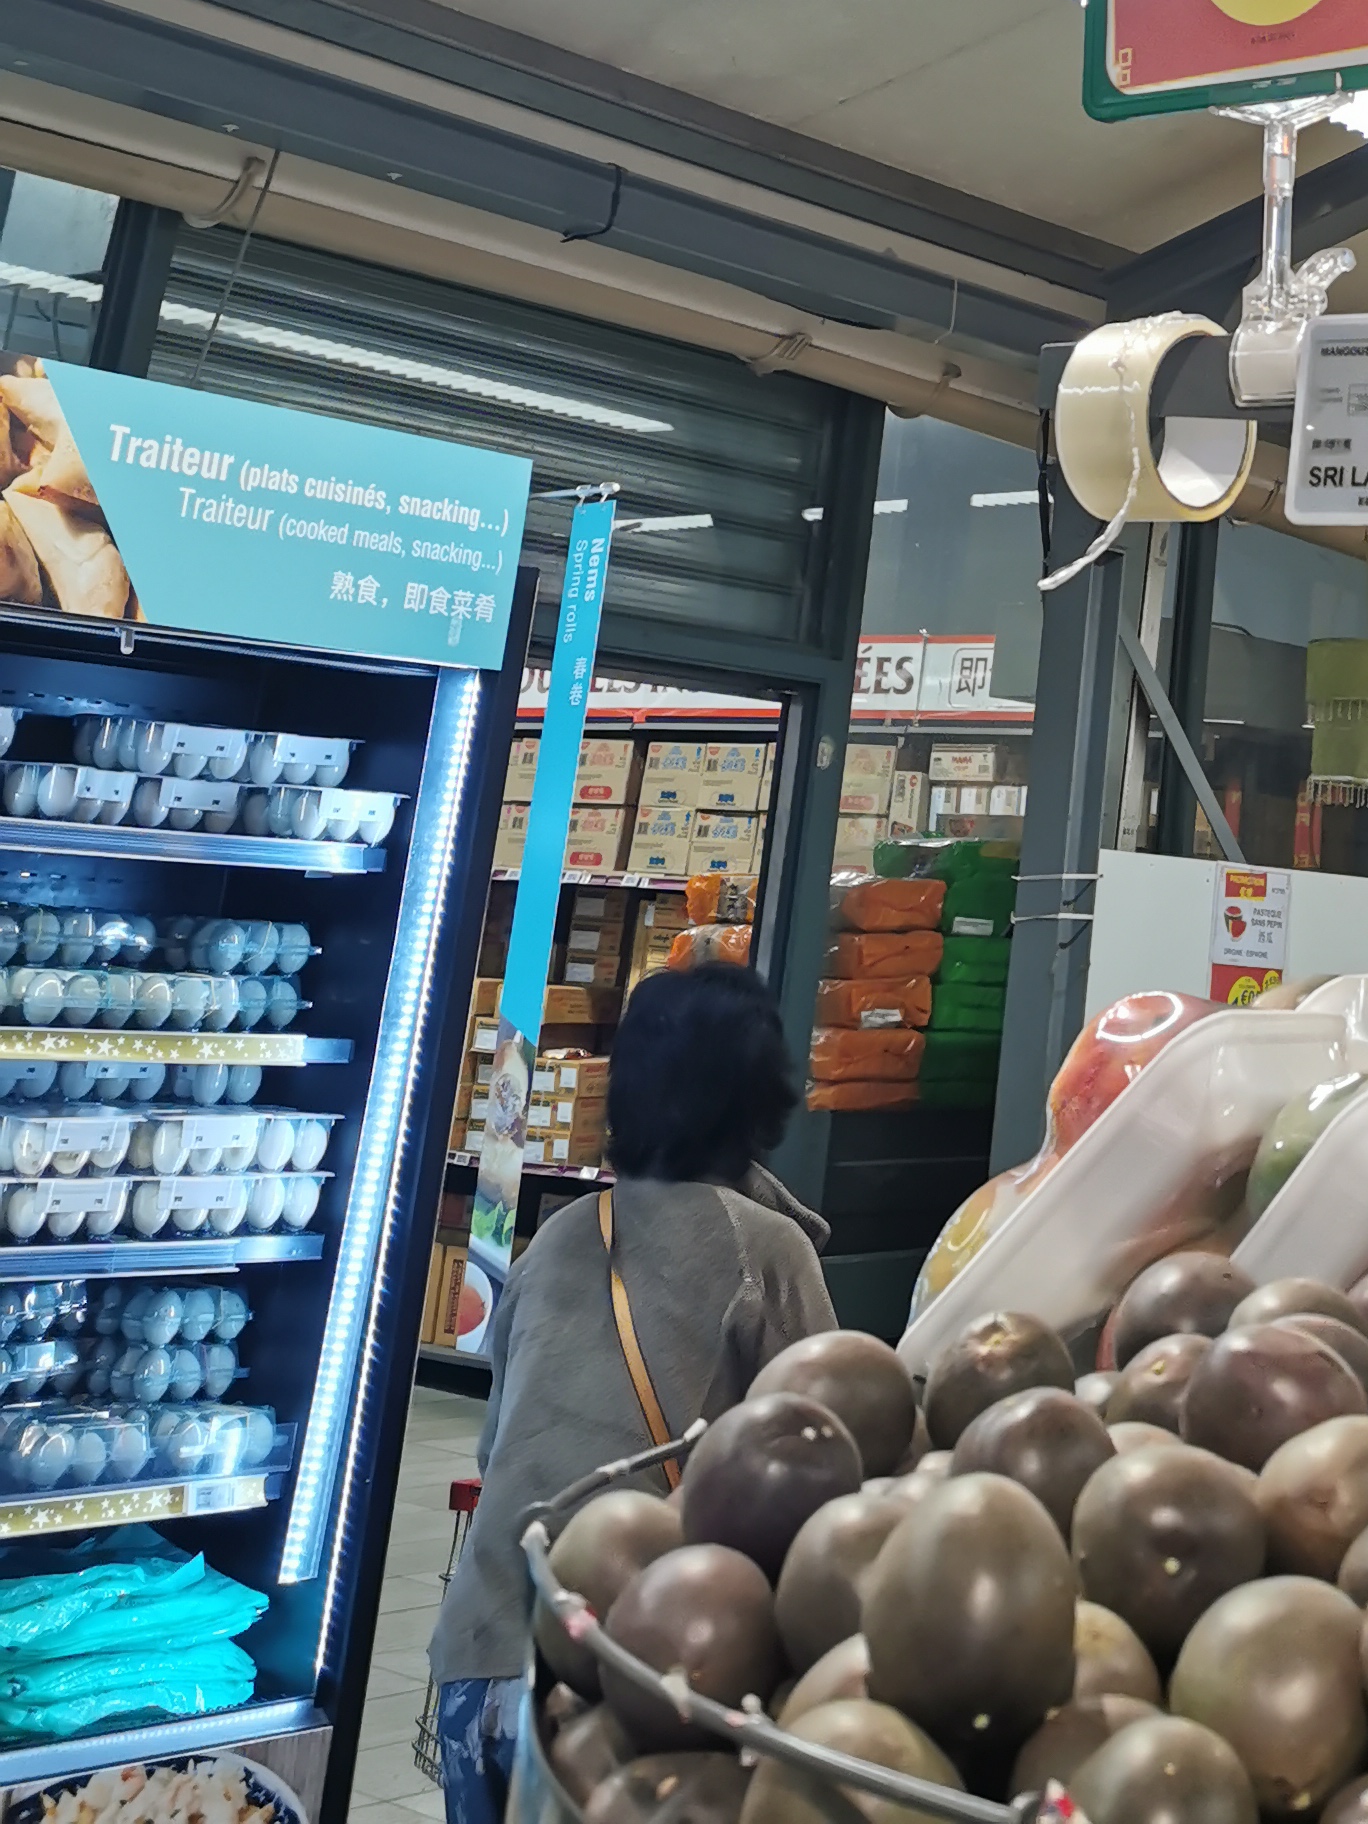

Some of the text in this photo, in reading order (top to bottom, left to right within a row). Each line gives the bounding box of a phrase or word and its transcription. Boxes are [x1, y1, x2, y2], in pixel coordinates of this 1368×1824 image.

[109, 423, 235, 482] Traiteur
[239, 459, 299, 494] (plats
[304, 474, 391, 516] cuisinés,
[1309, 466, 1345, 488] SRI
[179, 486, 274, 533] Traiteur
[278, 511, 348, 545] (cooked
[353, 530, 406, 558] meals,
[563, 539, 589, 644] Spring rolls
[584, 537, 606, 602] Nems
[853, 645, 914, 695] ÉES
[956, 657, 989, 697] 即
